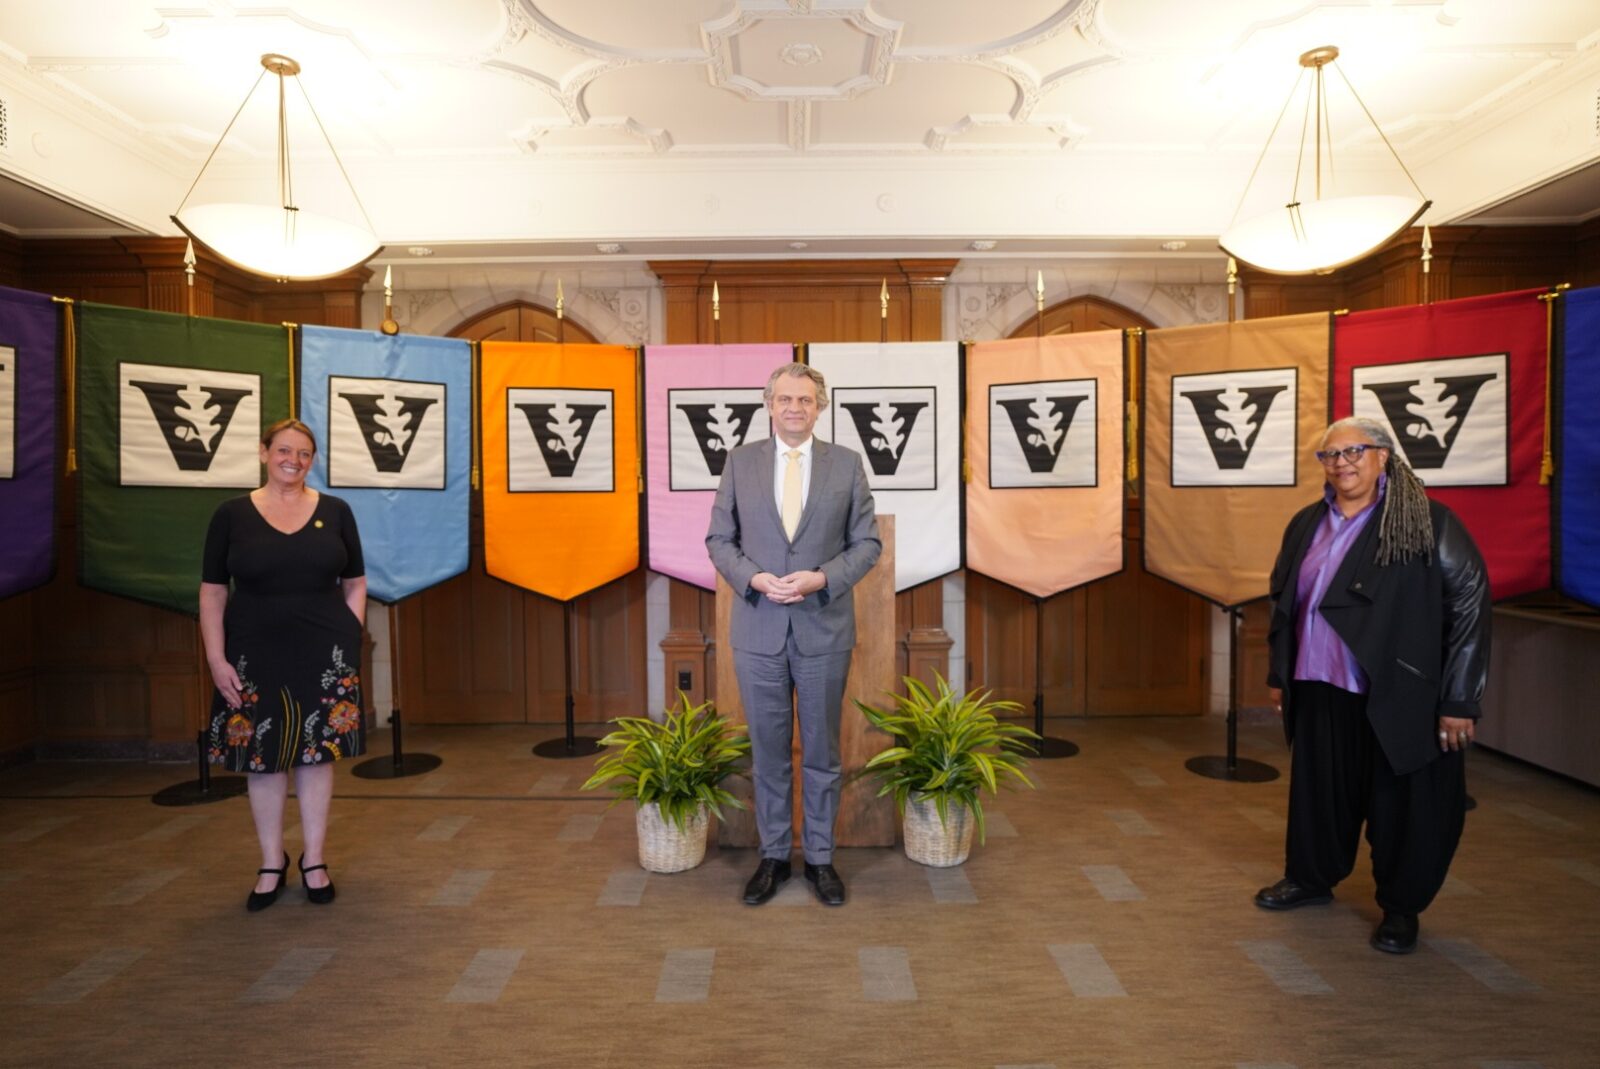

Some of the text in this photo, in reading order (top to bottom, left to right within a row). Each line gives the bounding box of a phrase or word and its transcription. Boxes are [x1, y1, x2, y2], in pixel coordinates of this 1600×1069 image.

[129, 379, 253, 472] V
[338, 392, 438, 473] V
[514, 403, 607, 477] V
[675, 403, 764, 476] V
[840, 401, 930, 476] V
[996, 394, 1089, 473] V
[1179, 384, 1288, 470] V
[1361, 372, 1498, 469] V
